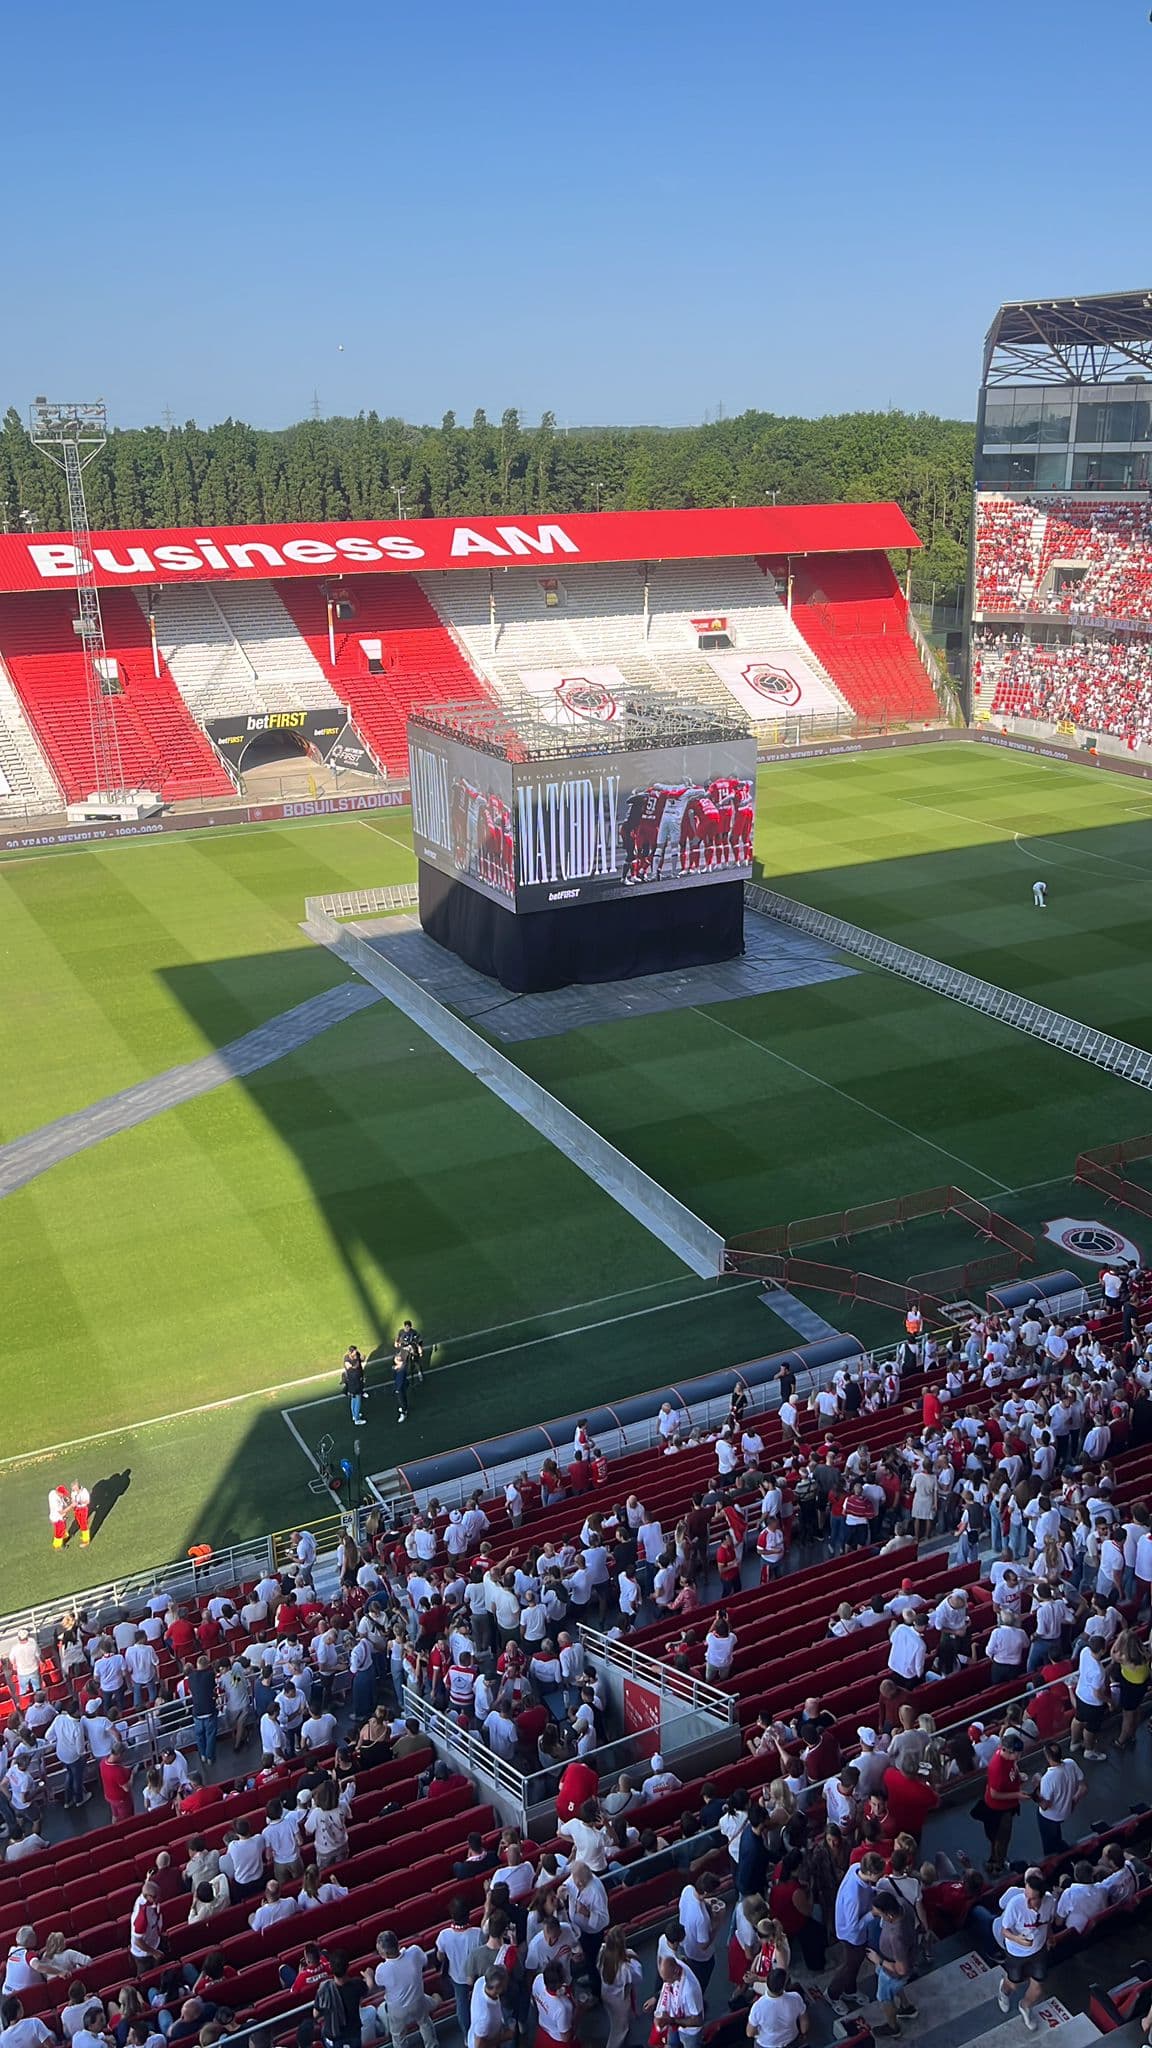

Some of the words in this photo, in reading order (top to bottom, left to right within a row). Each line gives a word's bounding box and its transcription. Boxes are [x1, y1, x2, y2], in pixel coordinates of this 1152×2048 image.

[27, 535, 426, 578] Business
[450, 523, 581, 557] AM
[247, 711, 308, 731] betFIRST
[314, 727, 340, 736] betFIRST
[217, 735, 245, 745] betFIRST
[340, 752, 363, 762] FIRST
[283, 793, 403, 818] BOSUILSTADION
[516, 775, 621, 889] MATCHDAY
[548, 888, 580, 901] betFIRST
[342, 1515, 353, 1524] E6
[1038, 2009, 1060, 2029] 24
